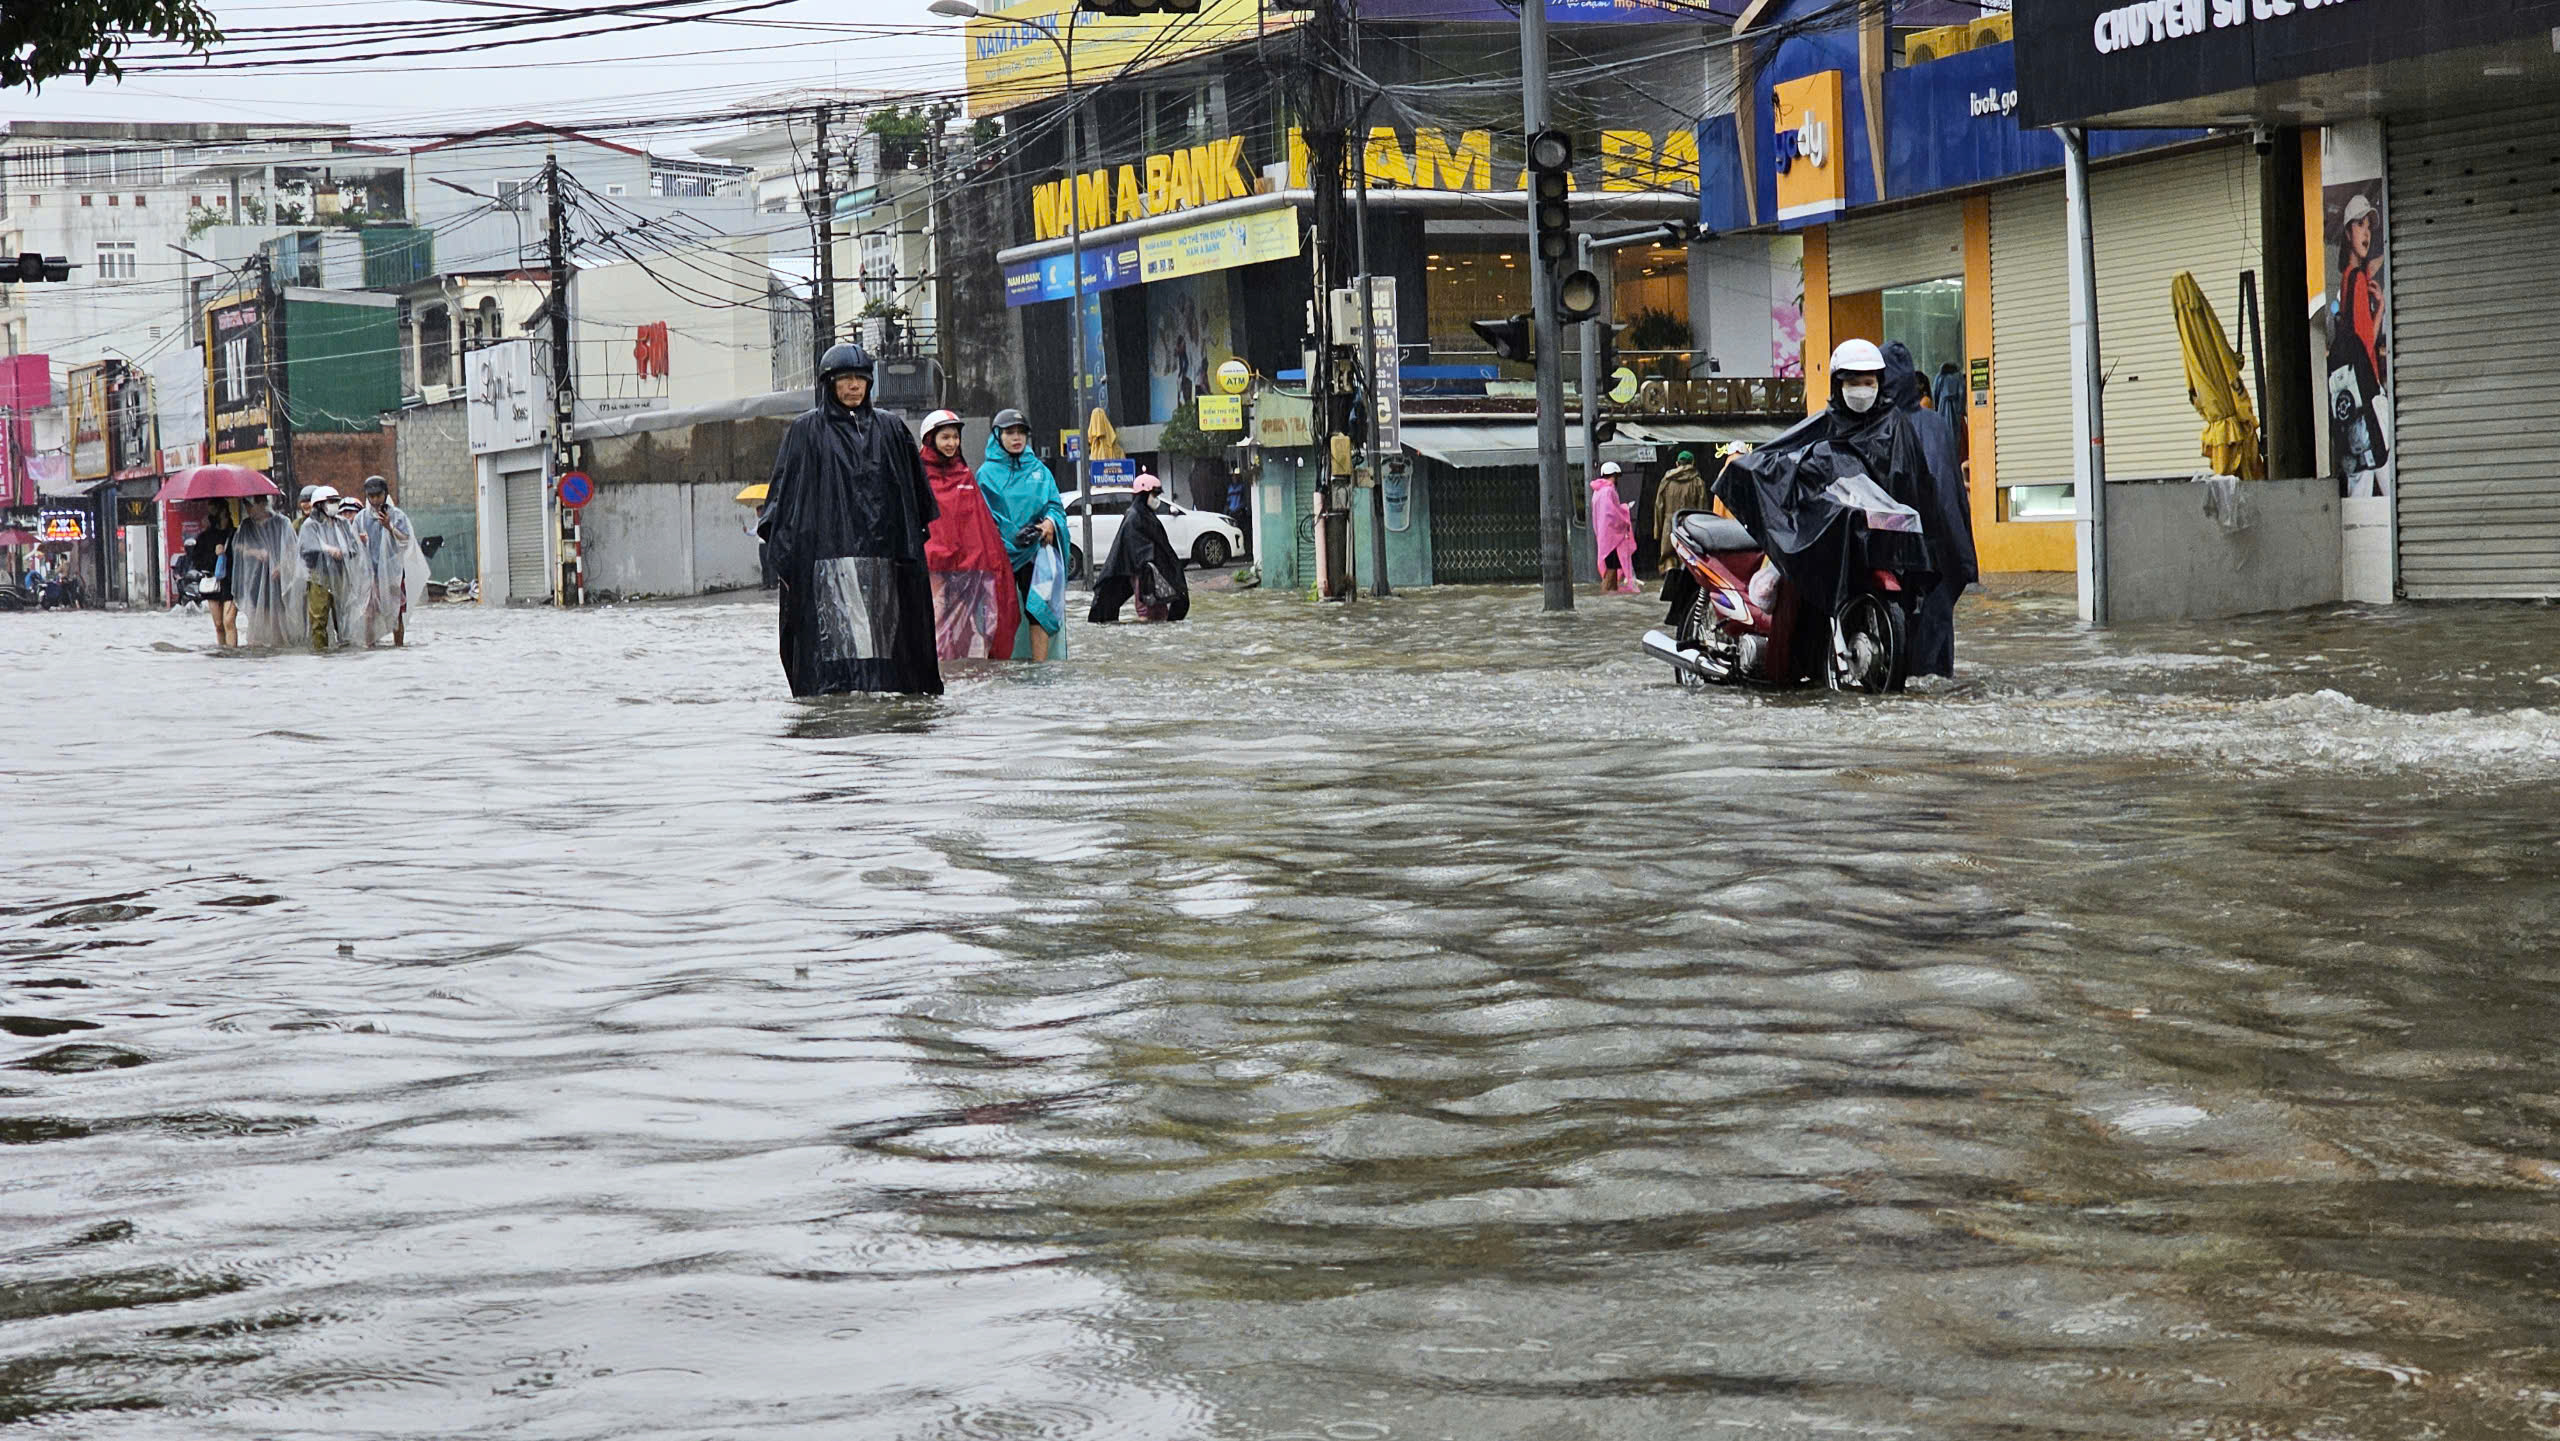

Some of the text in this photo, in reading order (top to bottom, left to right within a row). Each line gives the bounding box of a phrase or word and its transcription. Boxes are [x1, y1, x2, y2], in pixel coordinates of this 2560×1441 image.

[976, 30, 1007, 59] NAM
[1010, 26, 1019, 50] A
[1022, 10, 1060, 47] BANK
[1970, 87, 2001, 117] look
[1775, 110, 1826, 174] yody
[1032, 135, 1248, 241] NAM A BANK
[1226, 376, 1246, 386] ATM
[1640, 380, 1752, 413] GREEN
